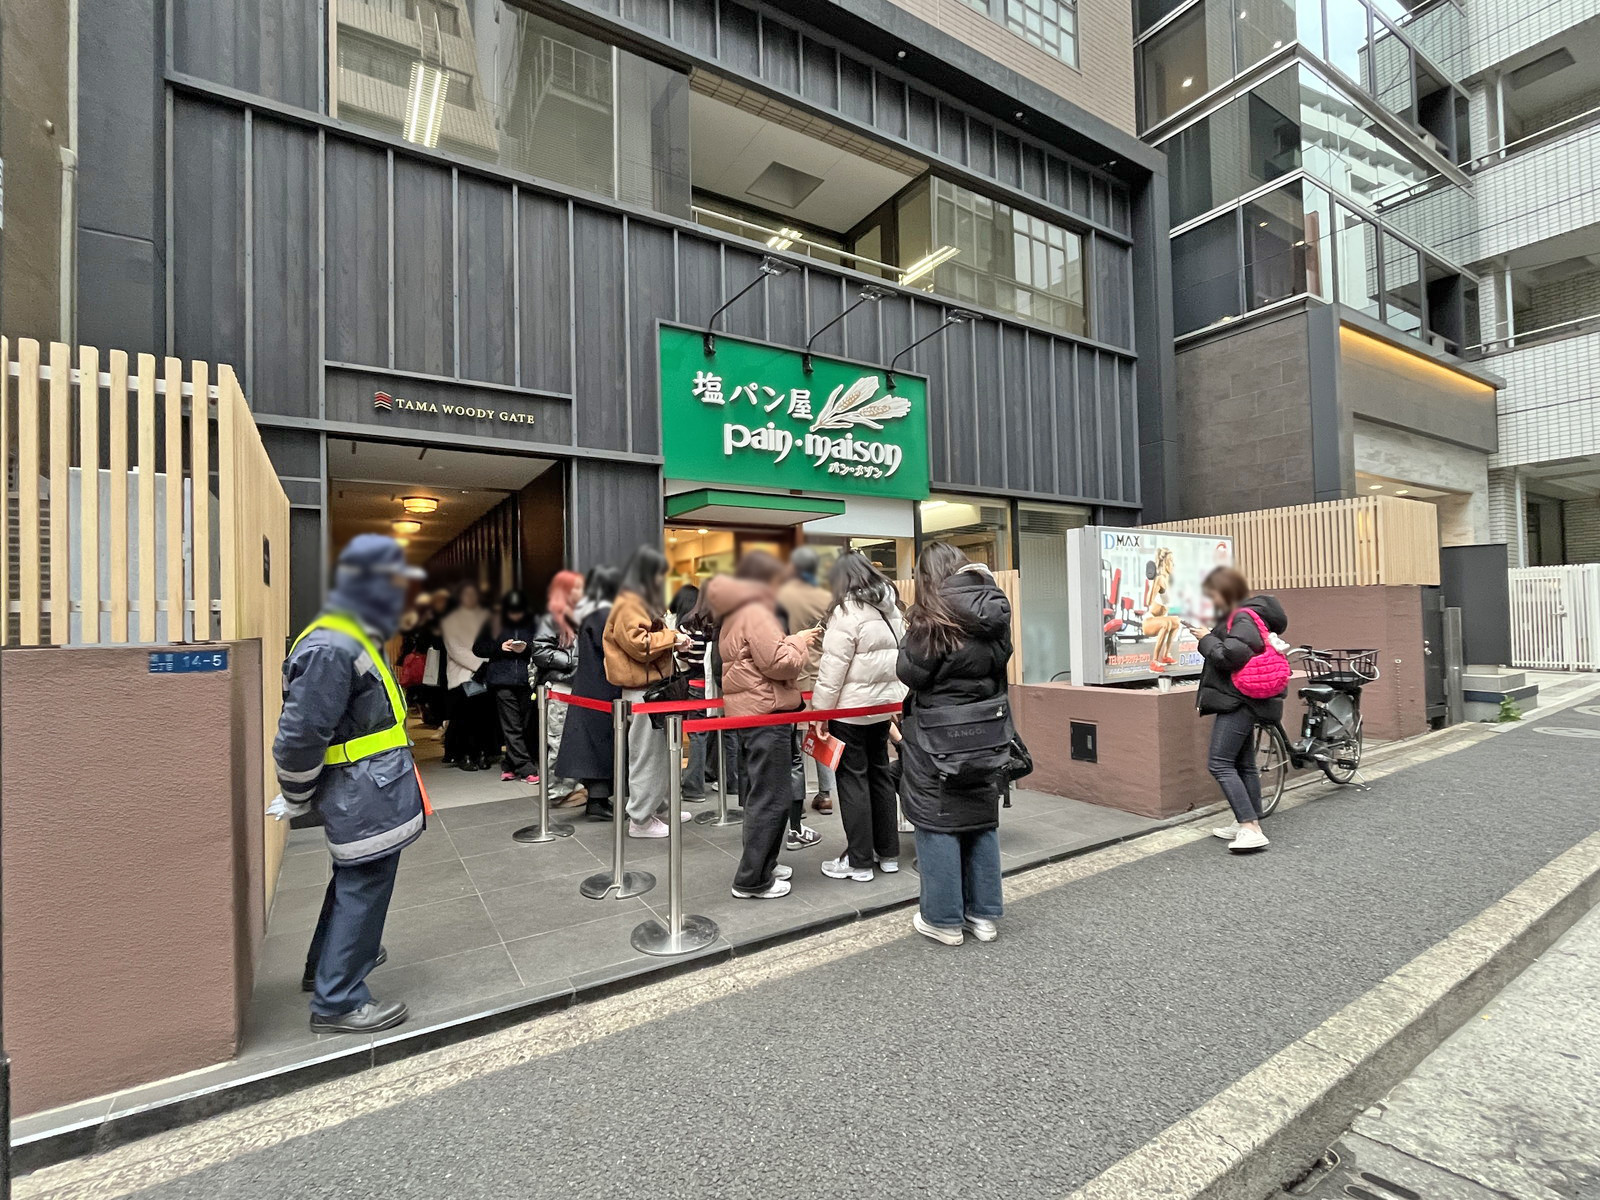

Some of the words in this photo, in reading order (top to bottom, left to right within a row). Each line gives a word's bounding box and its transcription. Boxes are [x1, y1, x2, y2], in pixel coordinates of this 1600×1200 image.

[395, 398, 438, 413] TAMA
[442, 404, 495, 419] WOODY
[499, 411, 535, 425] GATE
[692, 371, 814, 420] 塩パン屋
